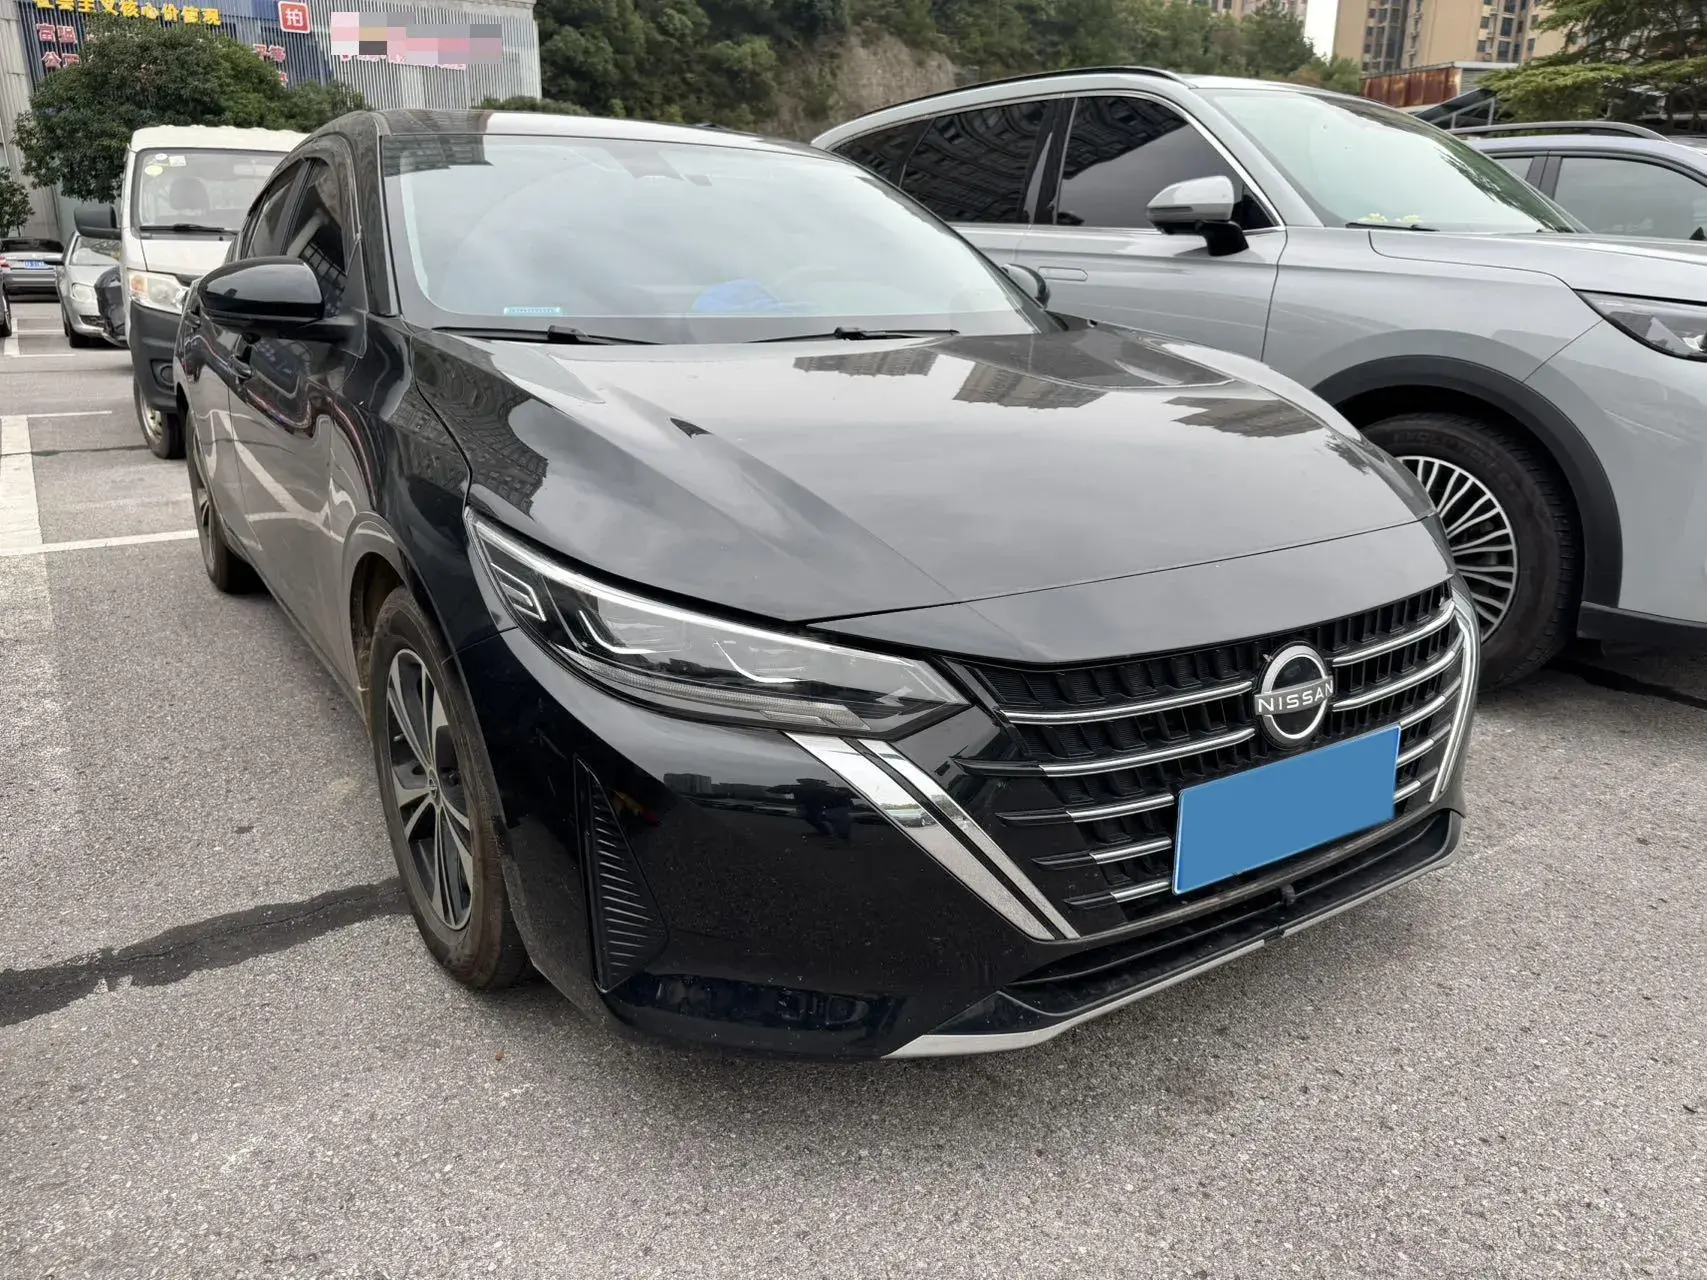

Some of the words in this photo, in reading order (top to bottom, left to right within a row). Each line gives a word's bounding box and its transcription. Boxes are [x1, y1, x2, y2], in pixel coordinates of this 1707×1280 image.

[286, 8, 304, 26] 拍
[36, 23, 77, 45] 富强
[1258, 681, 1333, 713] NISSAN
